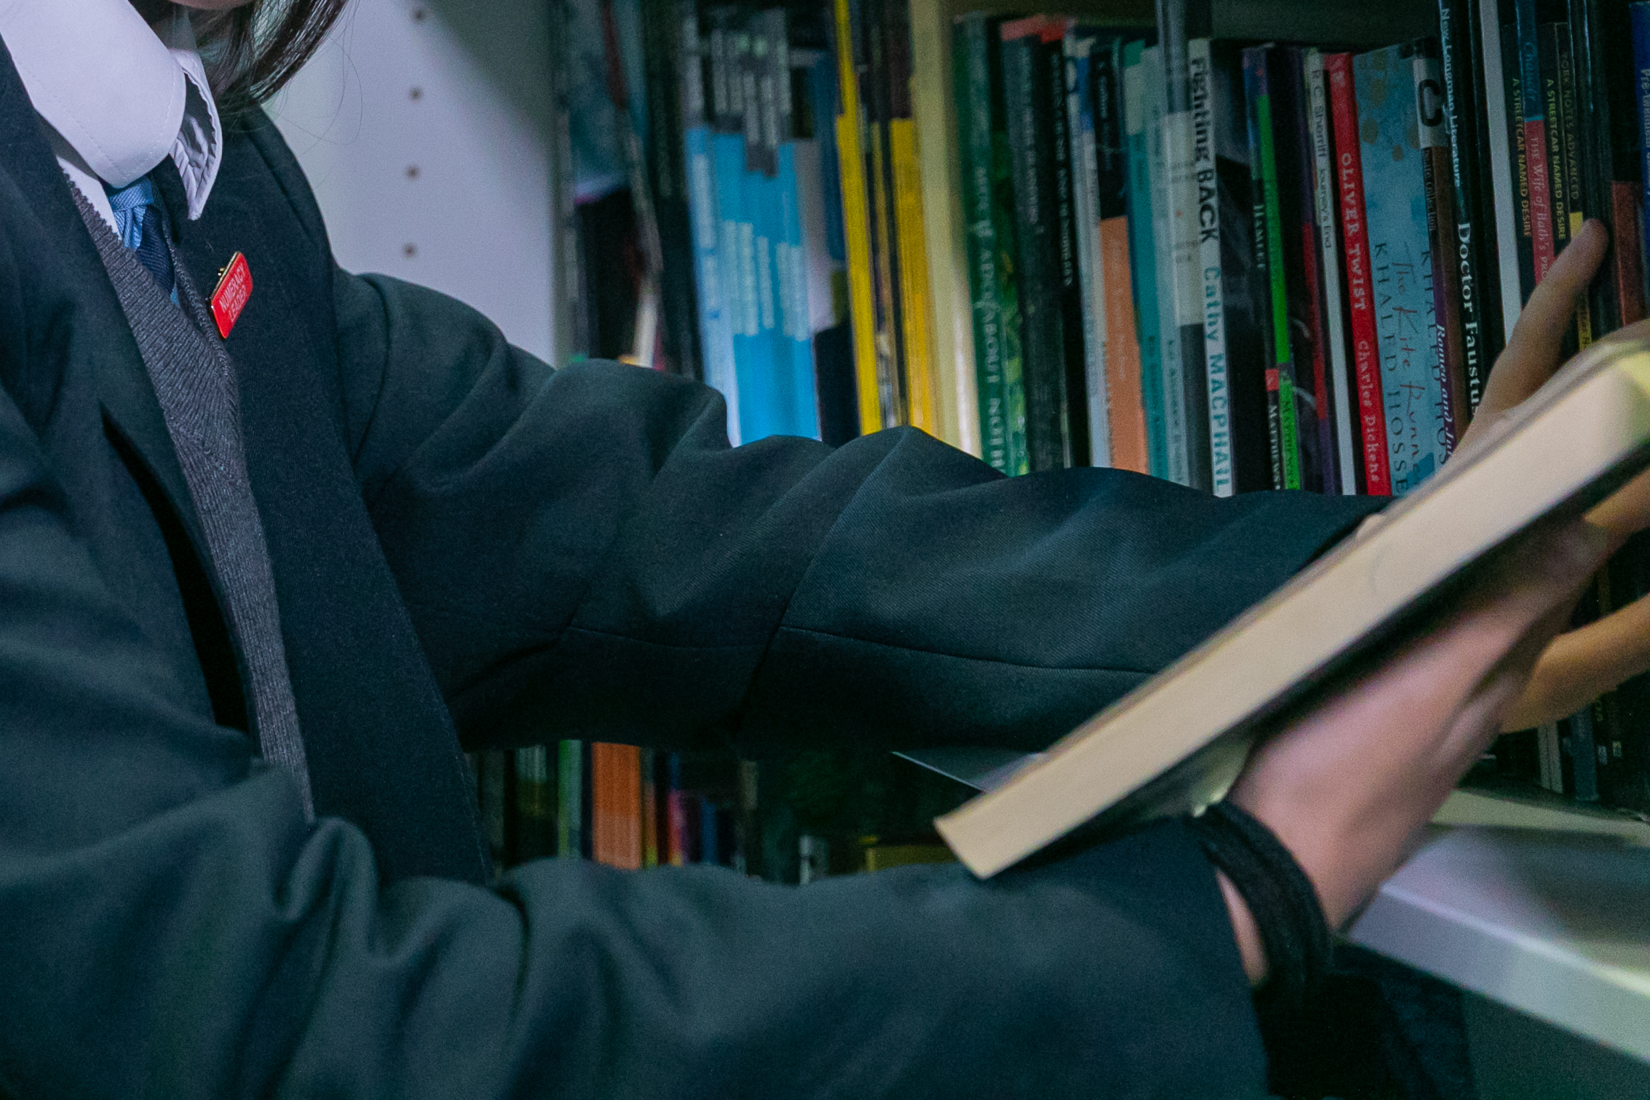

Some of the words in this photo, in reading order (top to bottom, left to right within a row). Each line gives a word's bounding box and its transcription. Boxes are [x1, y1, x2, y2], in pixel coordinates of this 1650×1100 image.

[1439, 7, 1451, 40] New
[1441, 44, 1456, 110] Longman
[1512, 77, 1519, 87] A
[1522, 41, 1540, 102] Chaucer
[1546, 78, 1554, 87] A
[1187, 56, 1212, 162] Fighting
[1313, 104, 1327, 159] Sherriff
[1512, 89, 1524, 152] STREETCAR
[1547, 90, 1558, 152] STREETCAR
[1563, 90, 1573, 128] NOTES
[1449, 114, 1462, 188] Literature
[1517, 153, 1528, 198] NAMED
[1529, 136, 1540, 160] THE
[1531, 162, 1544, 192] Wife
[1552, 154, 1561, 198] NAMED
[1566, 132, 1578, 200] ADVANCED
[1196, 168, 1217, 243] BACK
[1316, 167, 1328, 224] Journey's
[1339, 151, 1359, 236] OLIVER
[1521, 199, 1531, 238] DESIRE
[1533, 195, 1546, 207] of
[1556, 200, 1565, 240] DESIRE
[1322, 224, 1332, 249] End
[1535, 211, 1550, 251] Bath's
[1347, 243, 1366, 311] TWIST
[1456, 221, 1476, 312] Doctor
[1200, 266, 1223, 343] Cathy
[1374, 241, 1398, 373] KHALED
[1392, 303, 1423, 370] Kite
[1436, 323, 1449, 382] Romeo
[1357, 339, 1375, 408] Charles
[1465, 321, 1484, 416] Faustus
[1208, 352, 1231, 492] MACPHAIL
[1440, 387, 1451, 422] and
[1364, 414, 1382, 484] Dickens
